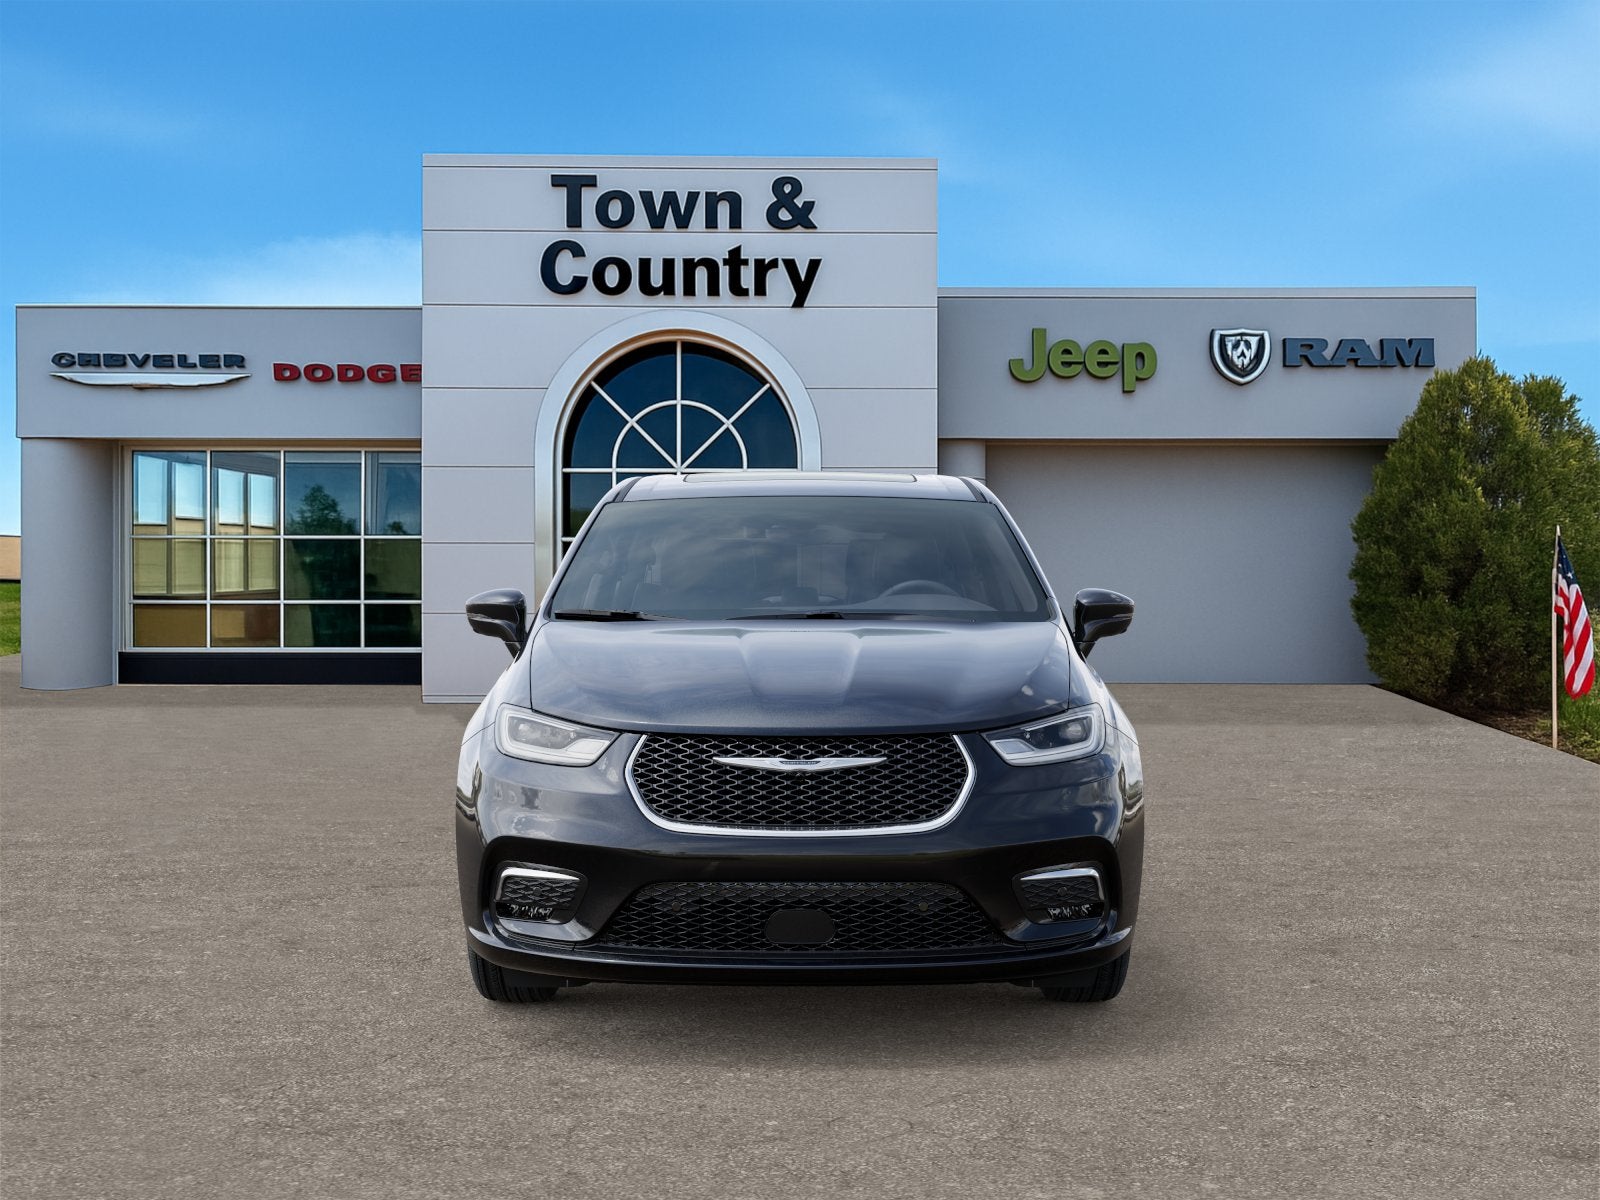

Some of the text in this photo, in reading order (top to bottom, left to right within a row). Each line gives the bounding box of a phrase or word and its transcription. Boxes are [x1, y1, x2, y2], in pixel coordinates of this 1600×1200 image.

[551, 174, 818, 230] Town &
[540, 240, 822, 308] Country
[273, 363, 422, 383] DODGE
[1009, 328, 1157, 392] Jeep
[1283, 338, 1435, 367] RAM
